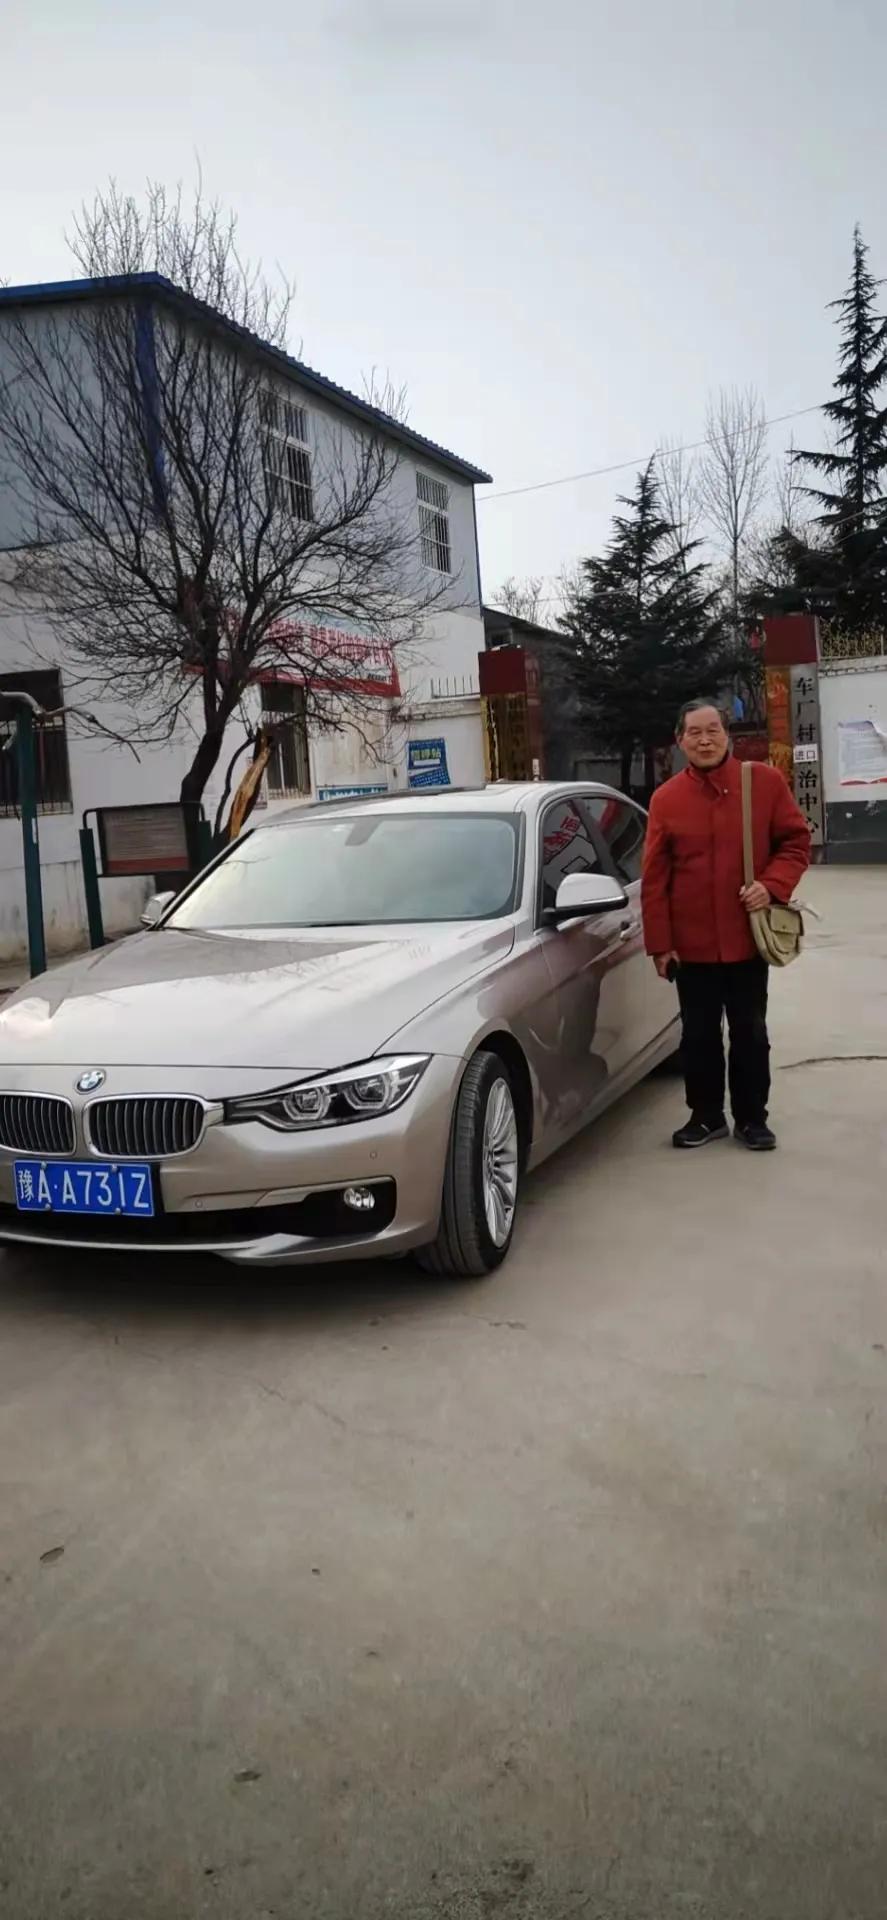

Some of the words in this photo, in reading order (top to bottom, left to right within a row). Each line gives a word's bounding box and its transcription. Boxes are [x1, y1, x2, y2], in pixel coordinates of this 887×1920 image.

[794, 677, 819, 833] 车厂村治中心
